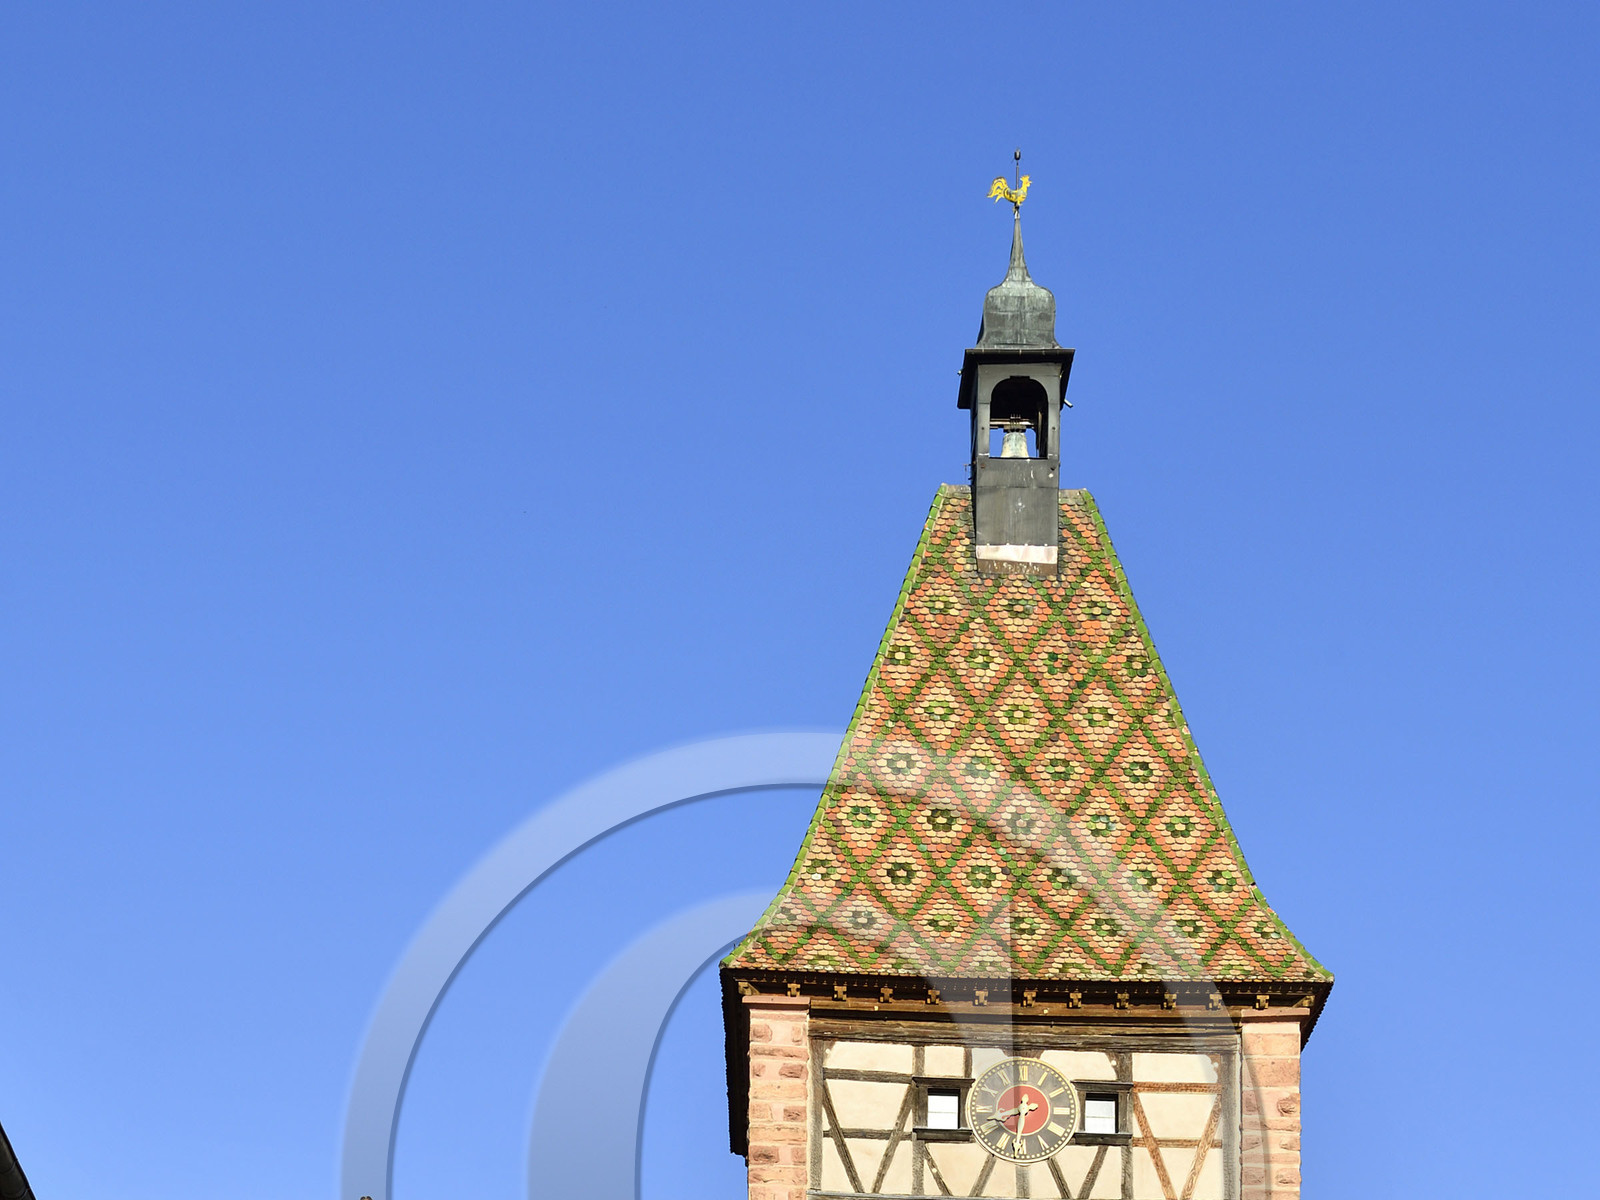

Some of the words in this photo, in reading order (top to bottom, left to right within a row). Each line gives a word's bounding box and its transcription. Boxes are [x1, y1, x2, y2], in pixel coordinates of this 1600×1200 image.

[997, 1069, 1010, 1086] XI
[1019, 1065, 1028, 1081] XII
[1037, 1071, 1048, 1086] I
[981, 1084, 998, 1097] X
[1048, 1087, 1065, 1098] II
[1053, 1107, 1070, 1115] III
[1037, 1134, 1049, 1151] V
